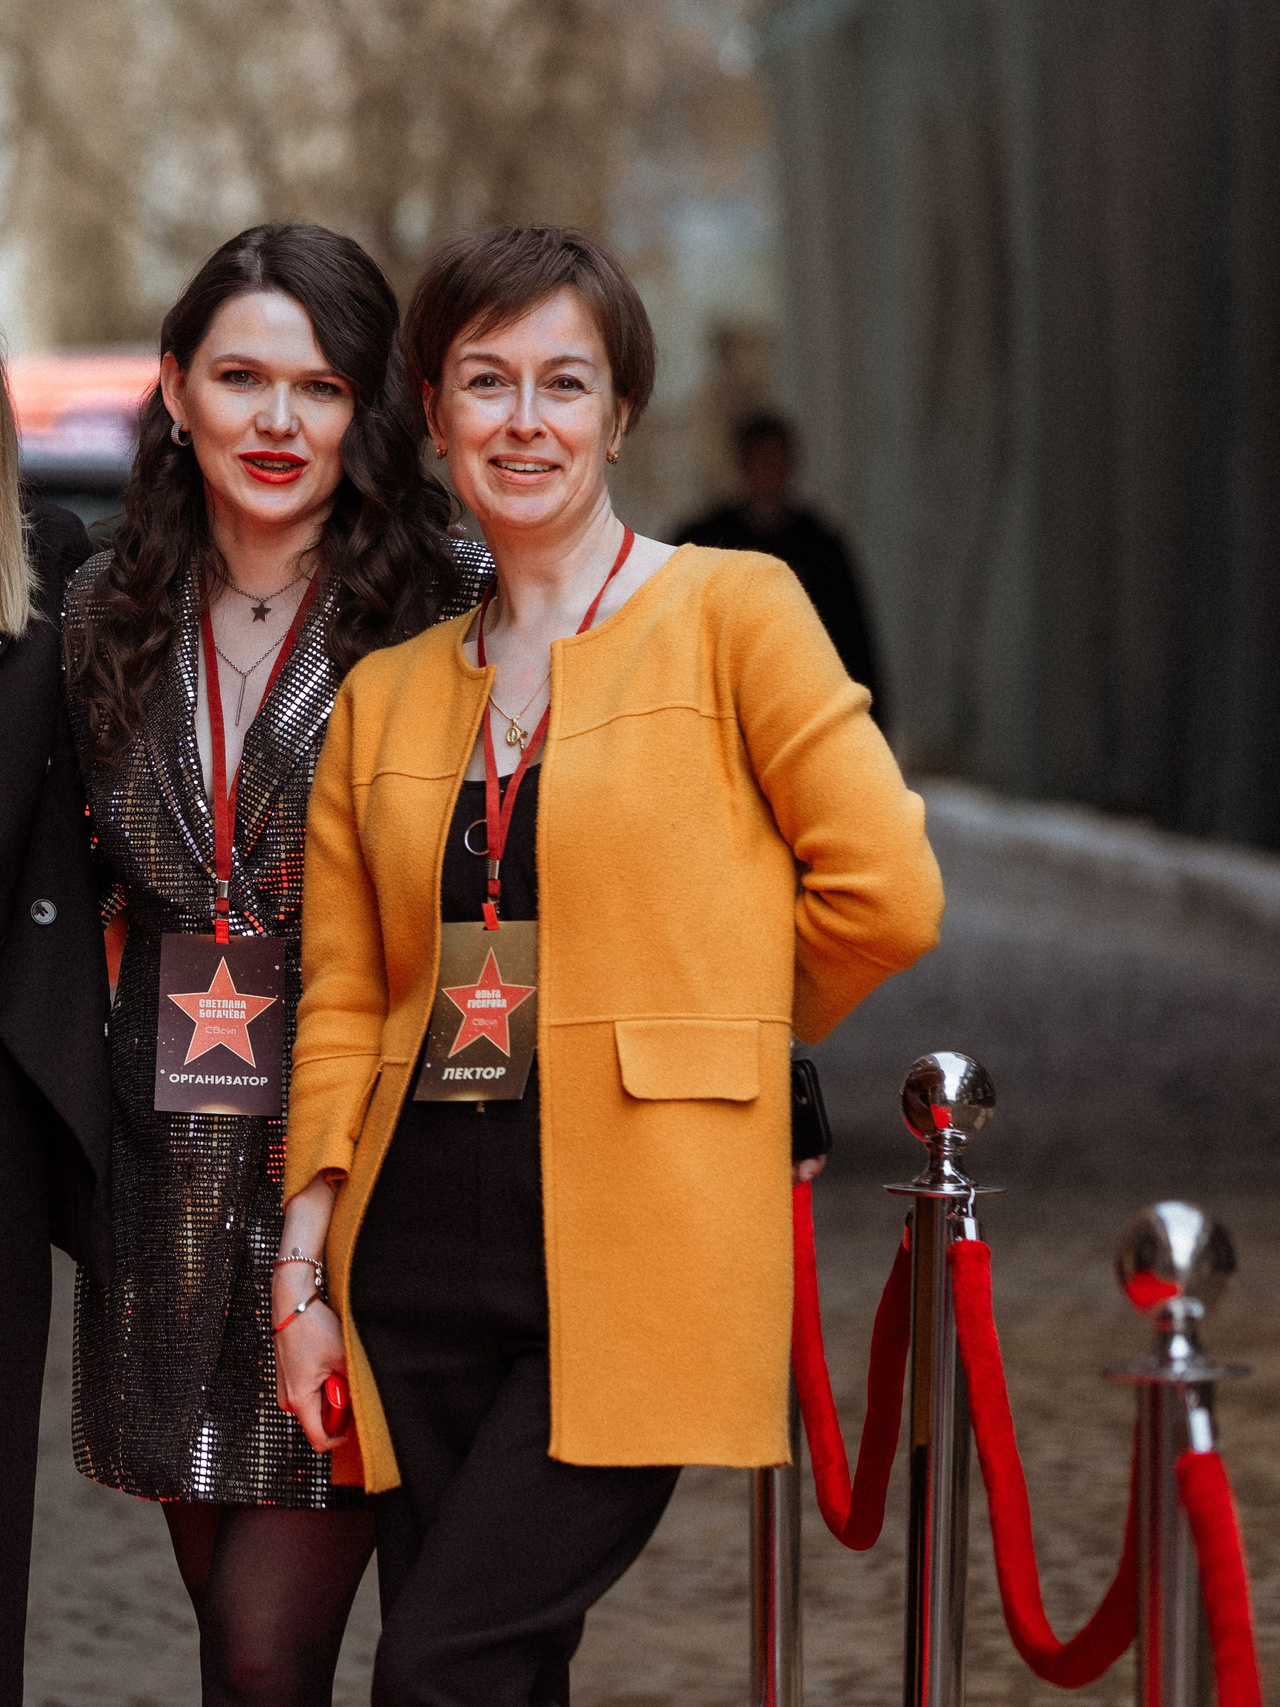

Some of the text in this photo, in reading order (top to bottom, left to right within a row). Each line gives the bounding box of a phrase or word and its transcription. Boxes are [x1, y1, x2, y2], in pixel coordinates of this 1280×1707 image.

[199, 999, 247, 1009] СВЕТЛАНА
[199, 1008, 246, 1019] БОГАЧЁВА
[169, 1073, 269, 1086] ОРГАНИЗАТОР
[442, 1067, 506, 1080] ЛЕКТОР
